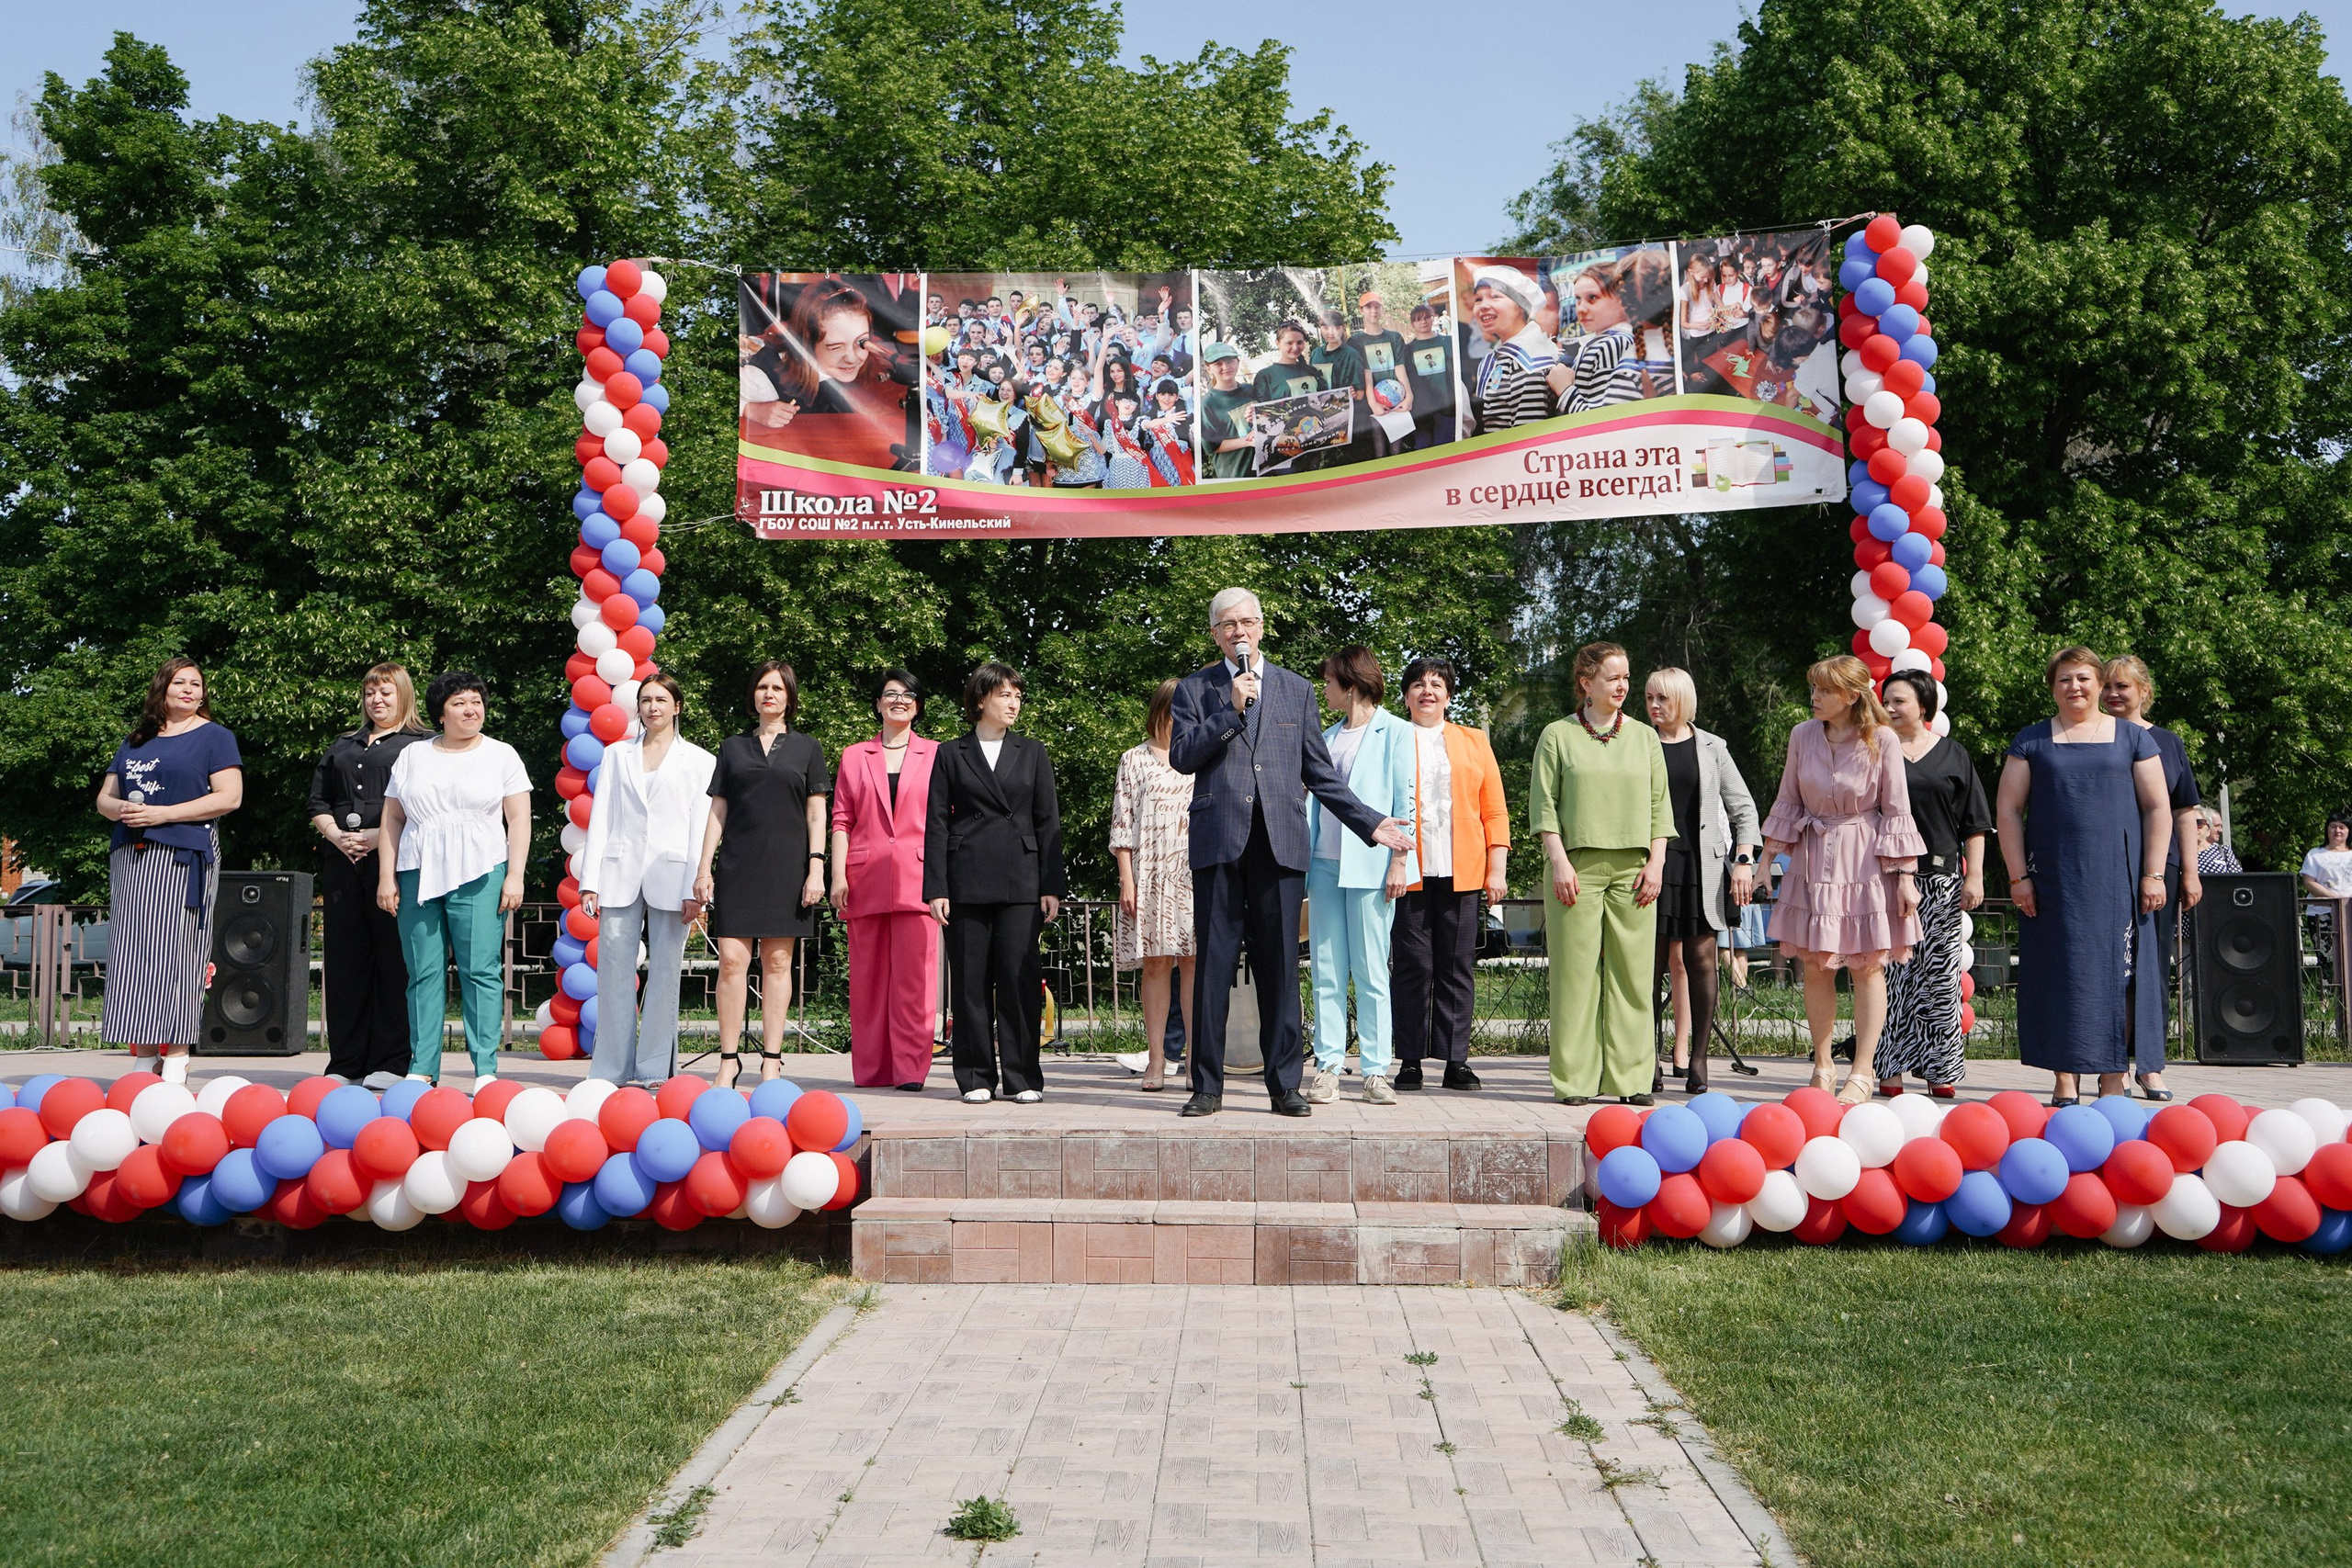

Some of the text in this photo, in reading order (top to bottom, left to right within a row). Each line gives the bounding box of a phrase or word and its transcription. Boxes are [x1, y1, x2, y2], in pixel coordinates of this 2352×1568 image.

[1523, 446, 1681, 478] Страна эта
[1445, 468, 1682, 510] в сердце всегда!
[759, 490, 938, 515] Школа №2
[759, 515, 1012, 530] ГБОУ СОШ №2 п.г.т. Усть-Кинельский
[131, 758, 160, 772] best
